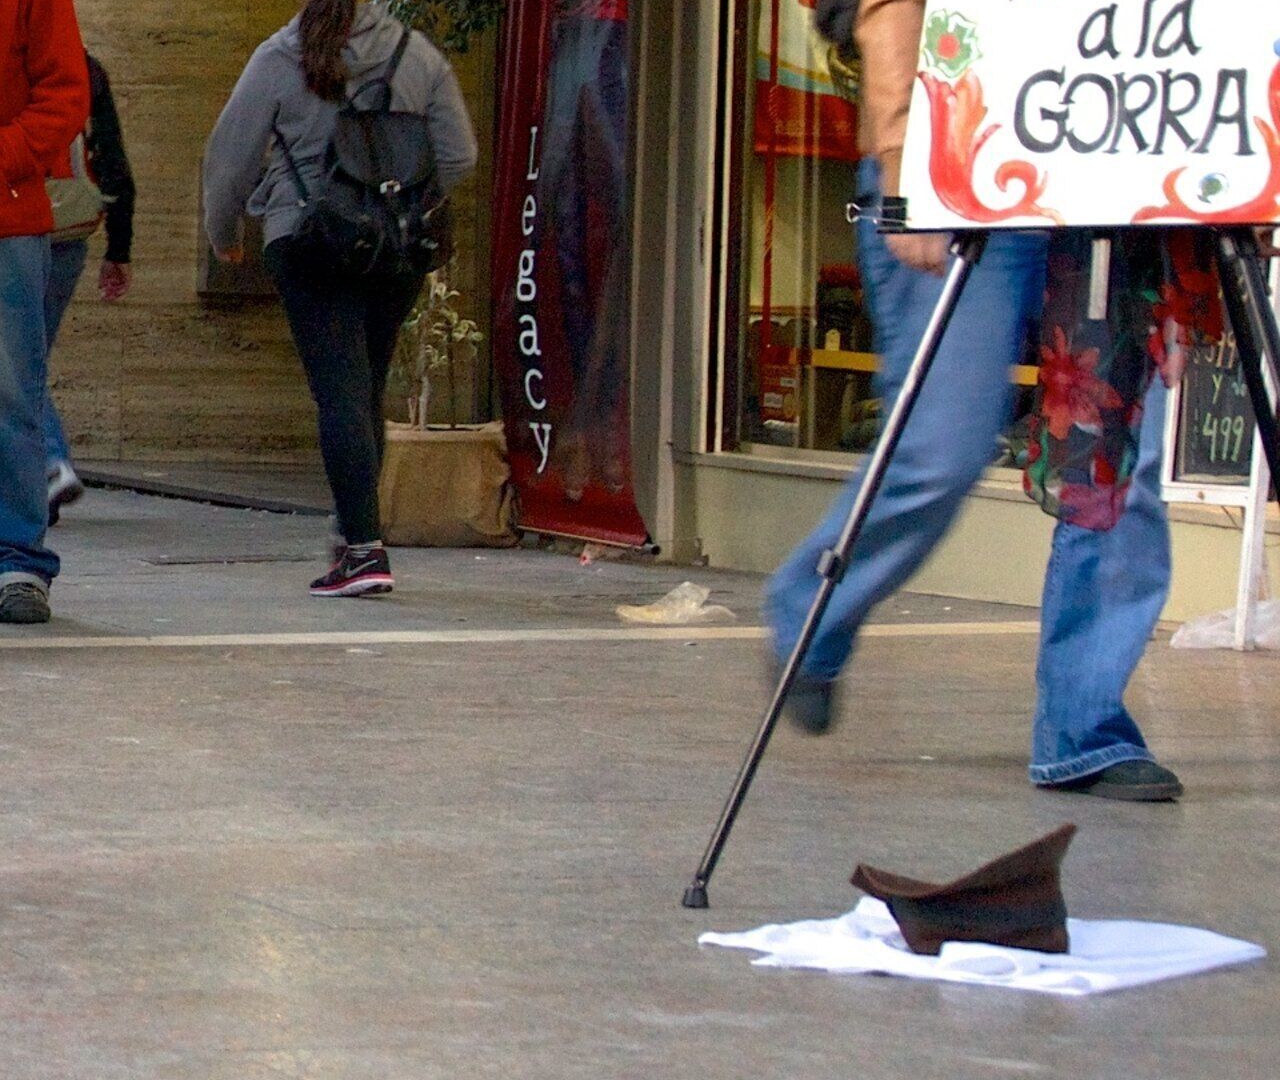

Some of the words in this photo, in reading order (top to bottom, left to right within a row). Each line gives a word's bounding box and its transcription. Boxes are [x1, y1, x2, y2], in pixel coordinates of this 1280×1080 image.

[1077, 3, 1121, 60] a
[1013, 66, 1256, 156] GORRA
[516, 126, 552, 474] Legacy
[1202, 412, 1244, 462] 499
